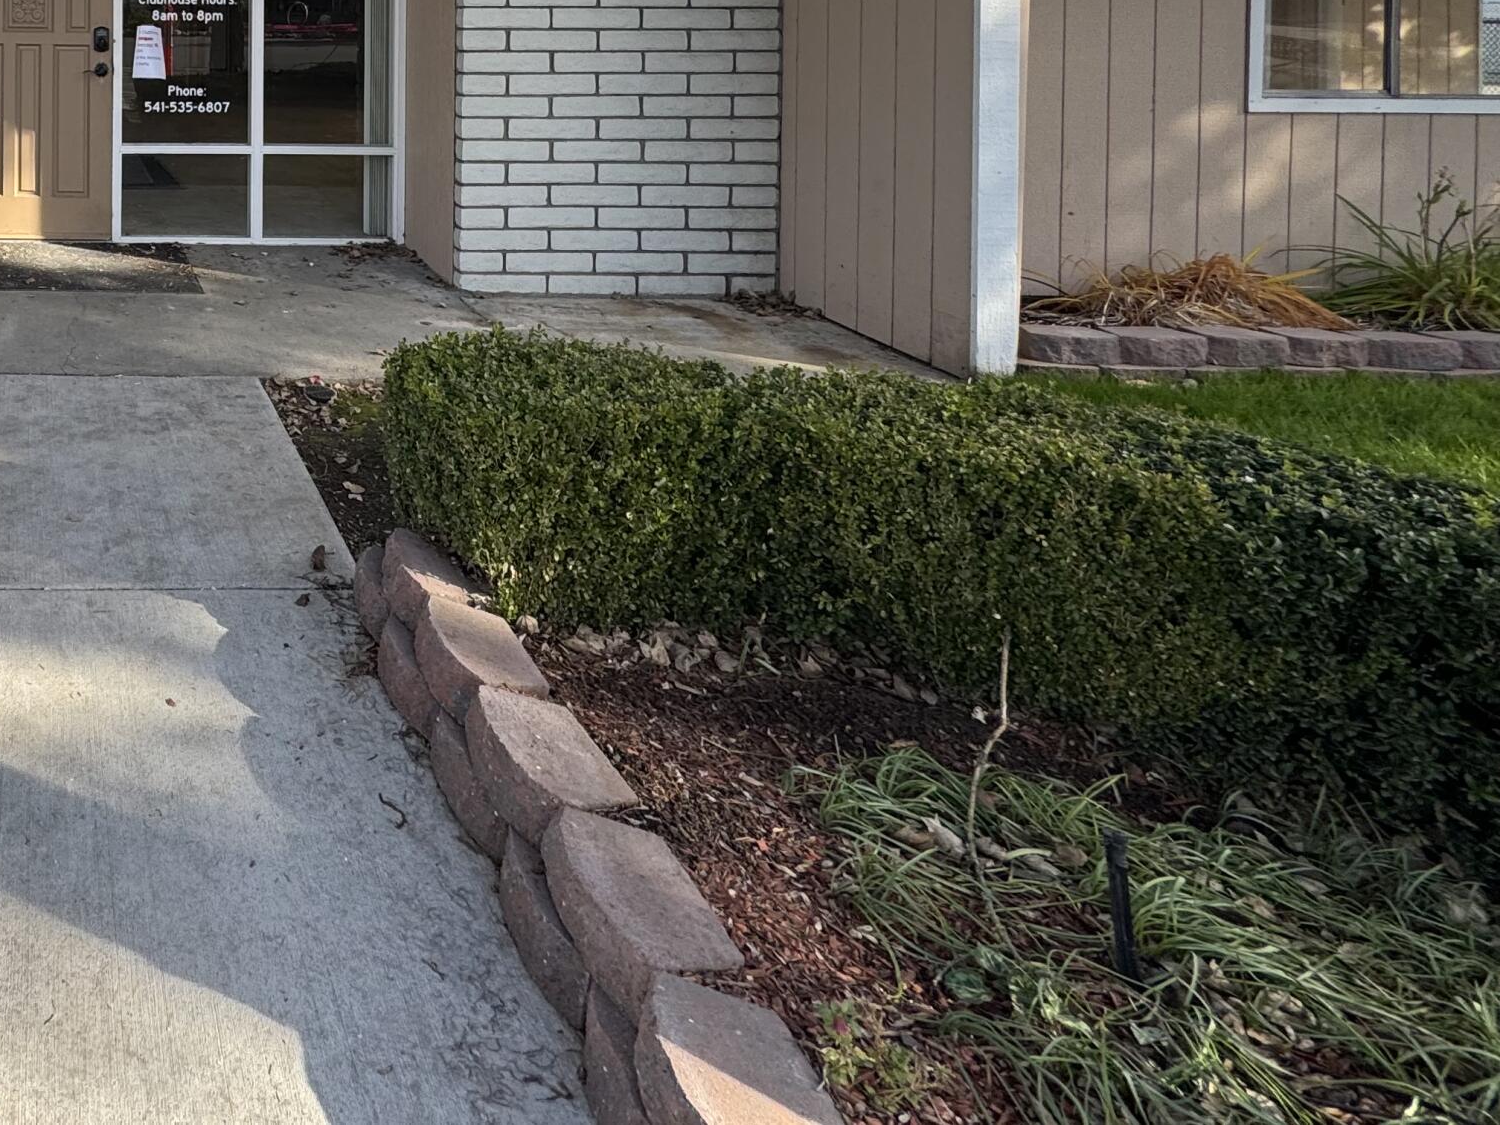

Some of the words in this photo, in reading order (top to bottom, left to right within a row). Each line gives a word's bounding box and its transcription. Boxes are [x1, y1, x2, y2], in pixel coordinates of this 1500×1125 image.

[152, 9, 178, 21] 8am
[182, 10, 194, 22] to
[196, 9, 224, 25] 8pm
[167, 84, 207, 97] Phone:
[144, 101, 231, 113] 541-535-6807
